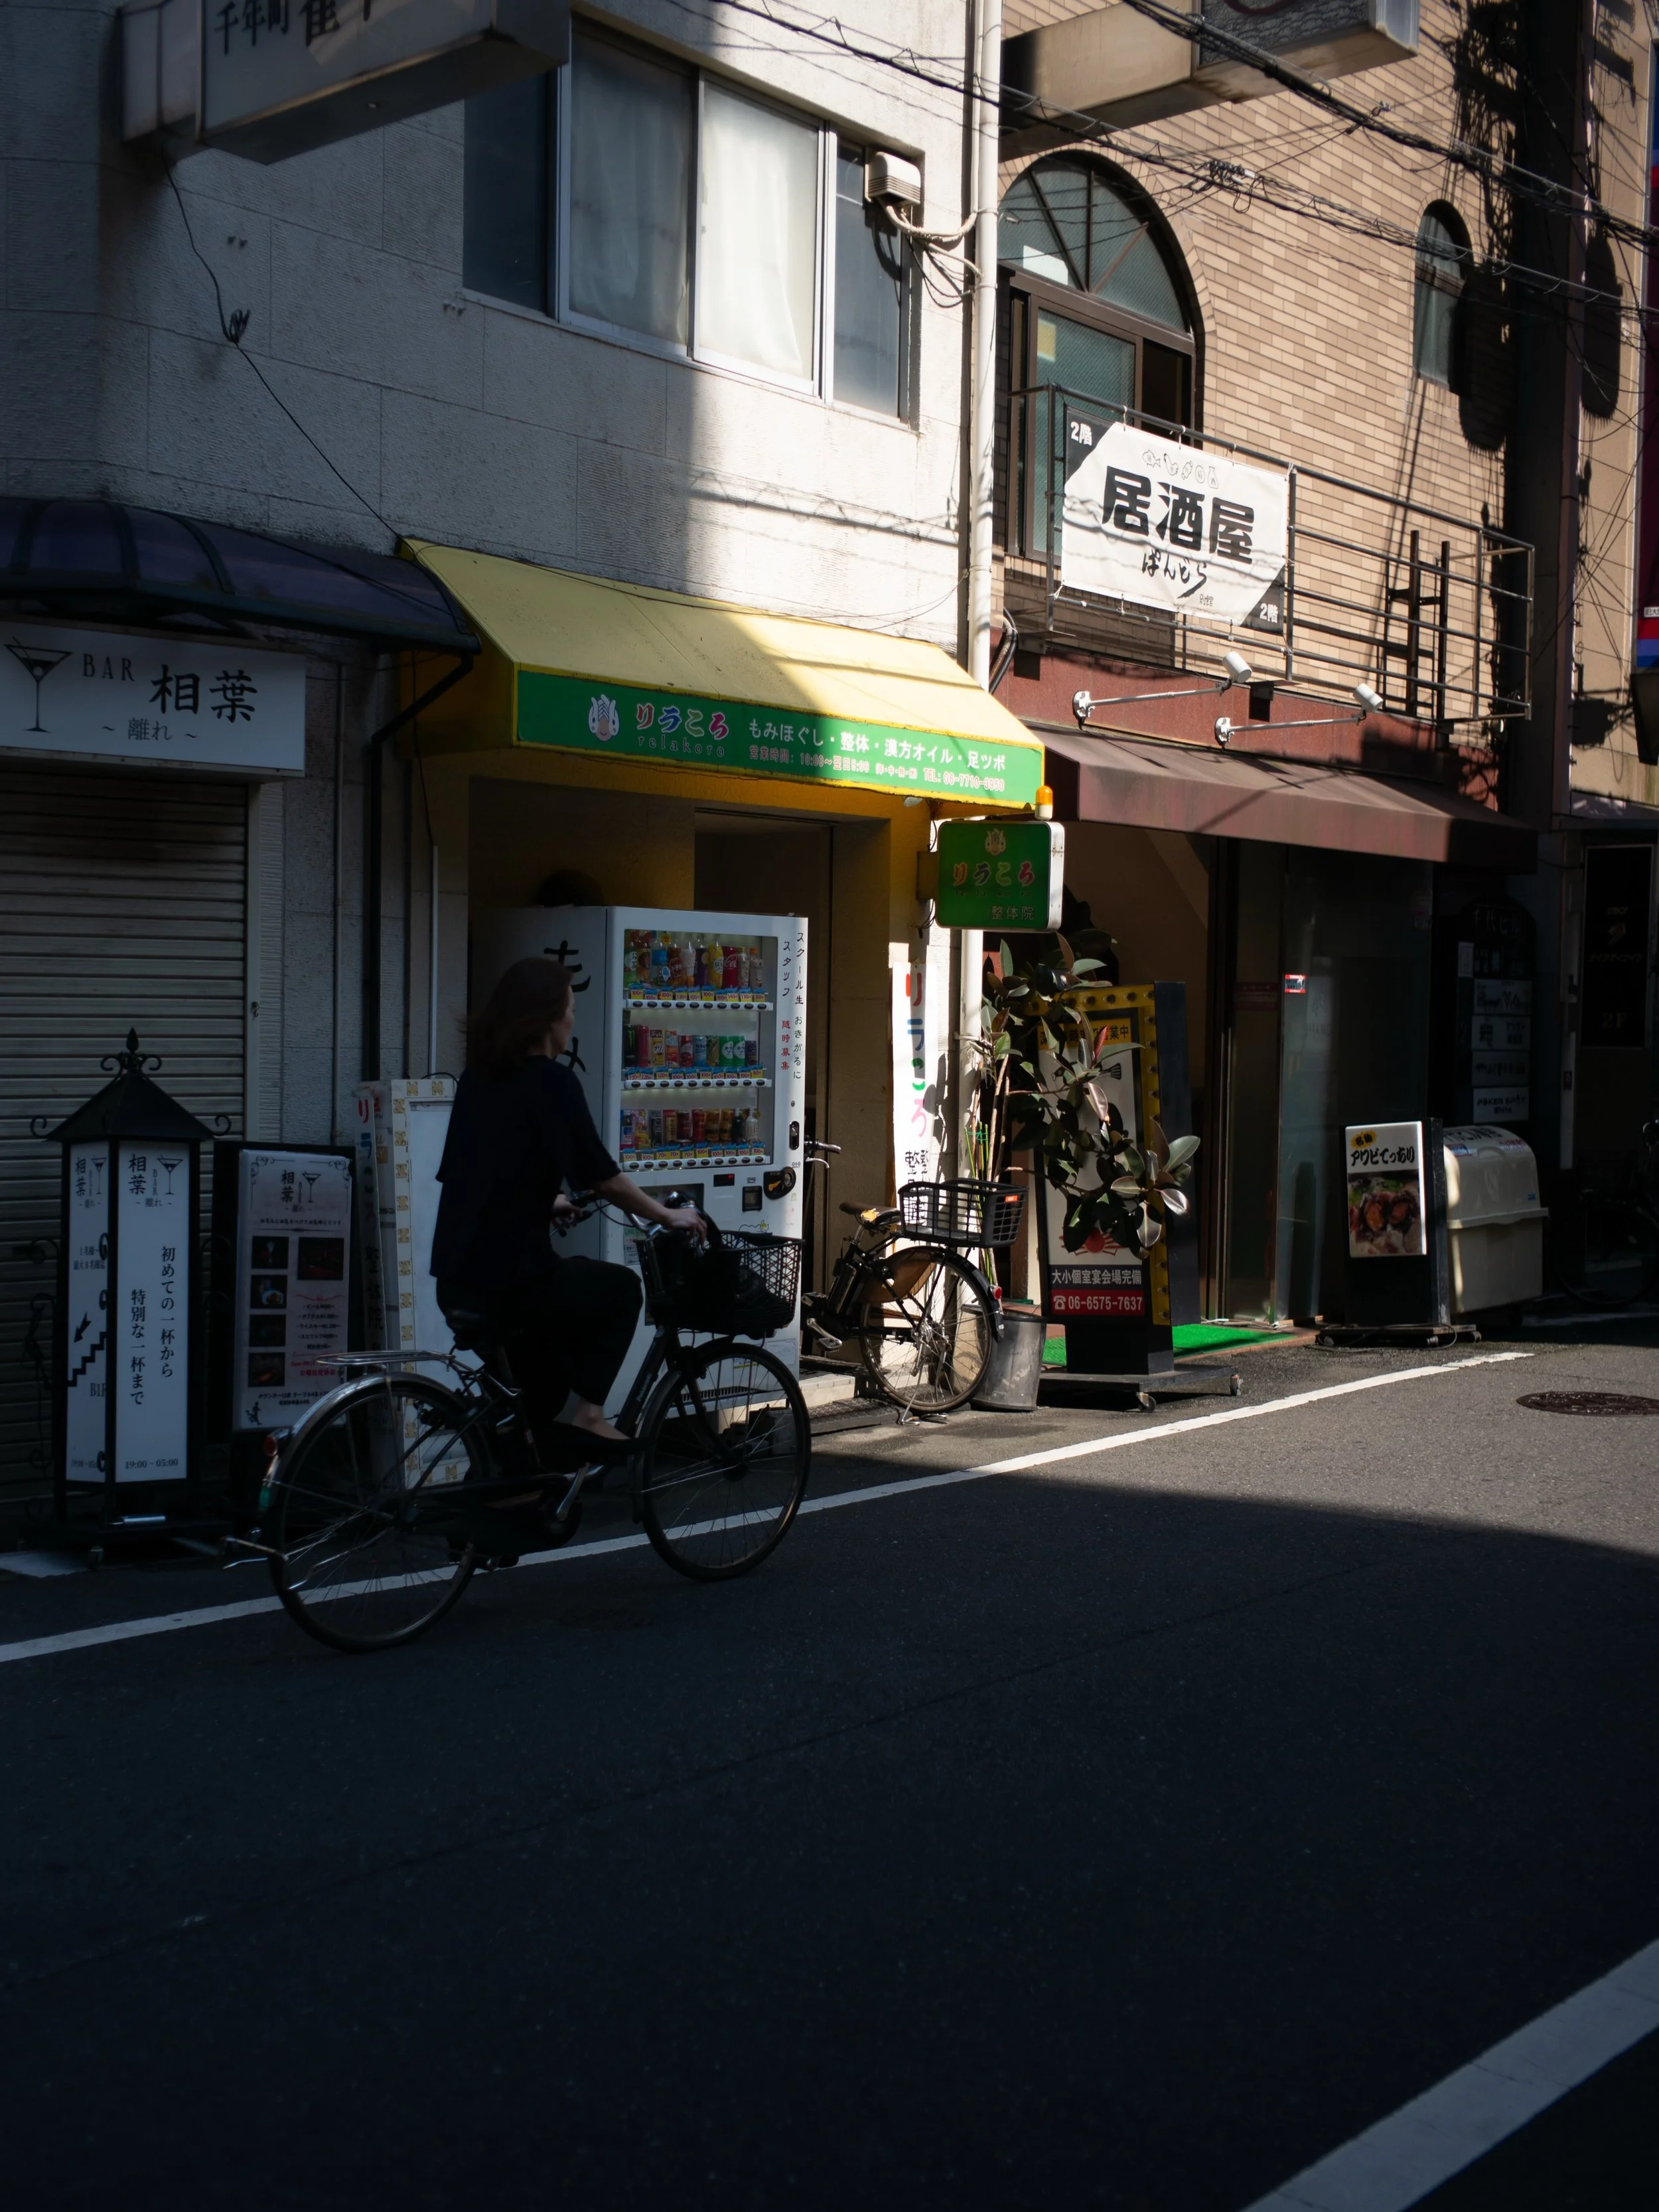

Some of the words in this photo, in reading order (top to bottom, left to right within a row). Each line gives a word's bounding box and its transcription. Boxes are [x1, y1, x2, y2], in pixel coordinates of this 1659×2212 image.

[1070, 421, 1093, 447] 2階
[1102, 465, 1255, 565] 居酒屋
[1260, 603, 1279, 624] 2階
[82, 653, 136, 682] BAR
[149, 664, 258, 723] 相葉
[638, 734, 725, 757] relakoro
[991, 905, 1035, 921] 整体院
[782, 941, 792, 997] スタッフ
[128, 1153, 147, 1195] 相葉
[1052, 1268, 1143, 1286] 大小個室宴会場完備
[161, 1246, 175, 1378] 初めての一杯から
[1068, 1295, 1143, 1311] 06-6575-7637
[130, 1289, 146, 1405] 特別な一杯まで
